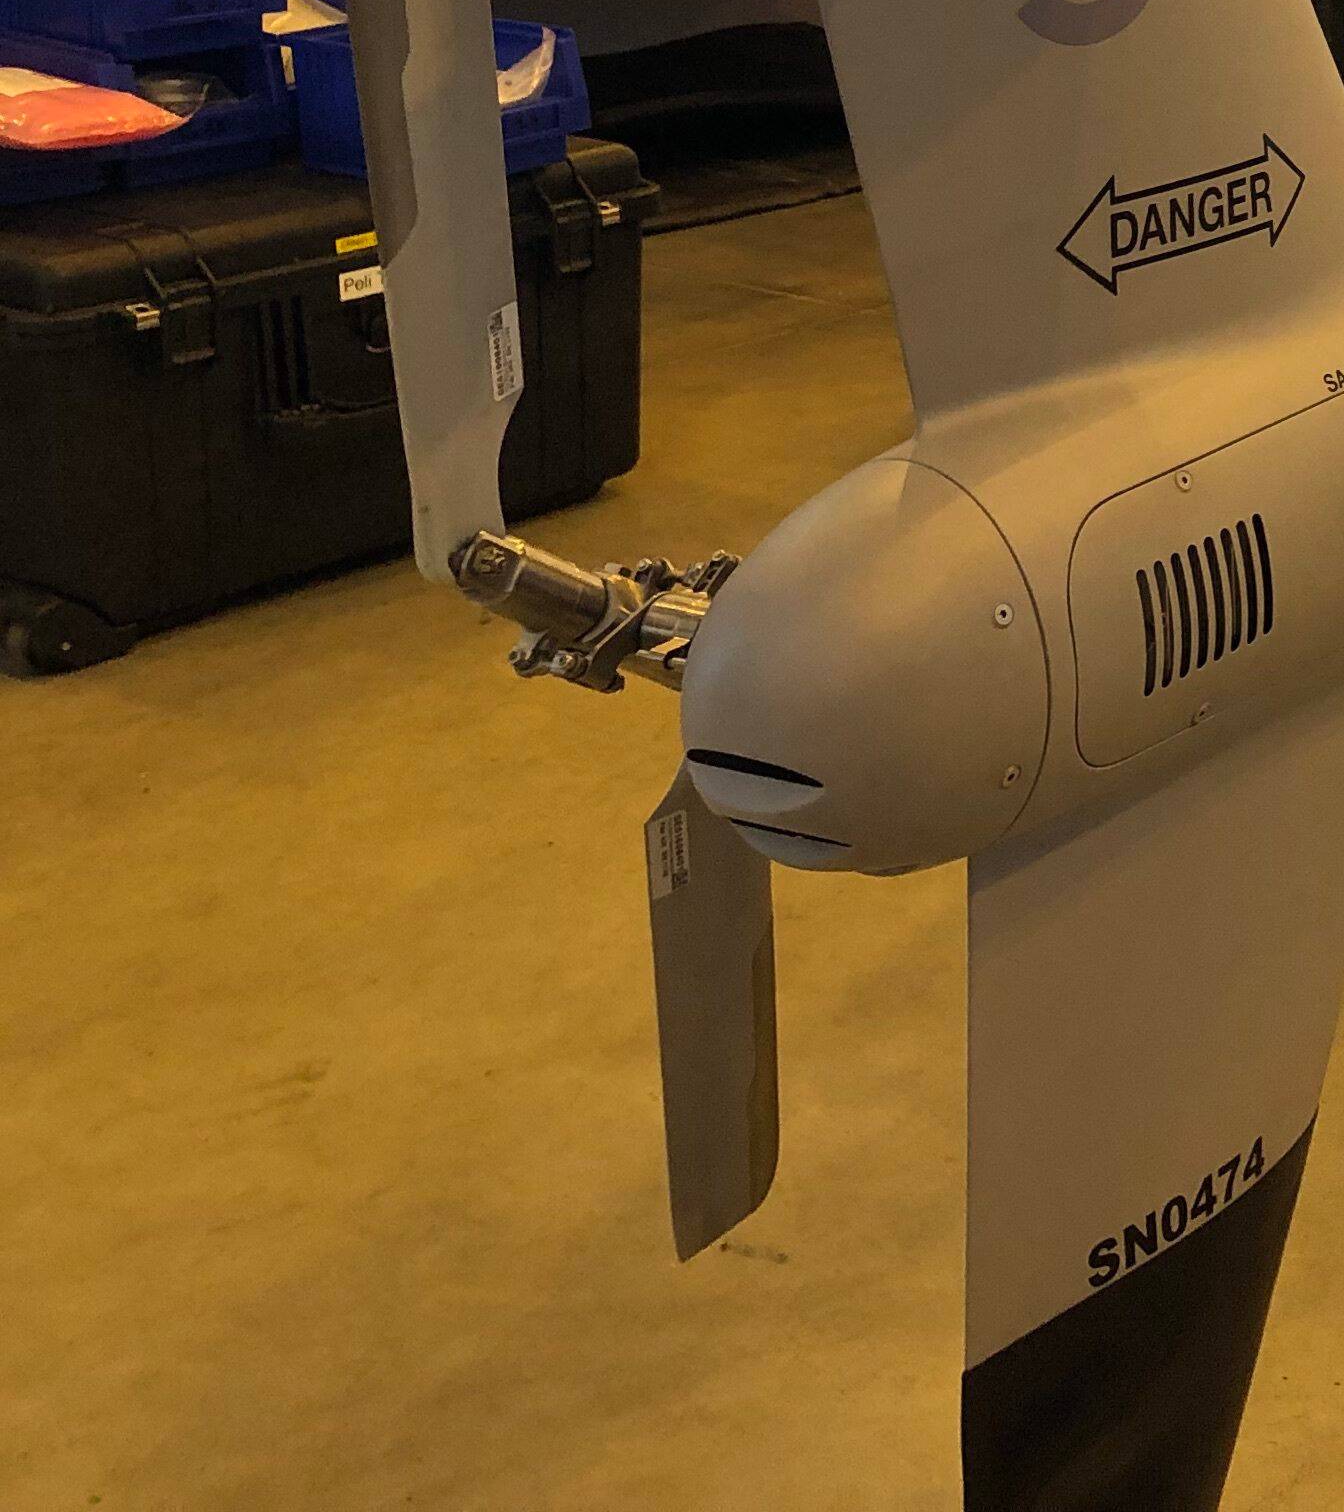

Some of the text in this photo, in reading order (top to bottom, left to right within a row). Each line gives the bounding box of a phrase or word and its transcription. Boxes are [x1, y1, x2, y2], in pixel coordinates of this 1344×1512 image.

[1110, 171, 1273, 259] DANGER
[344, 275, 372, 293] Peli
[1087, 1135, 1266, 1288] SN0474
